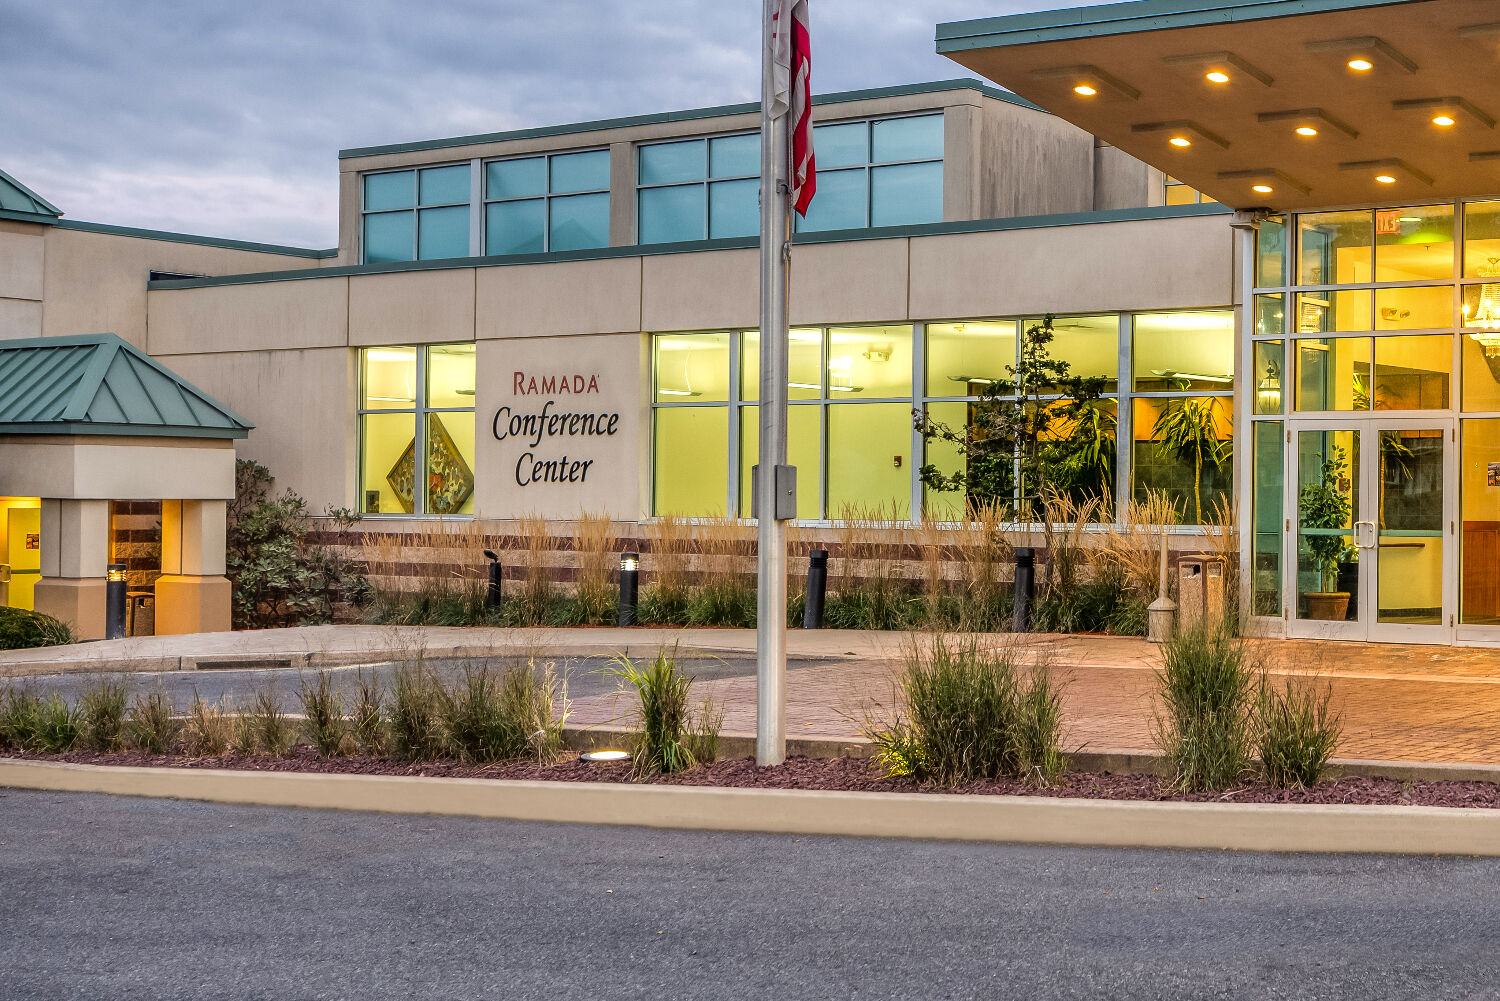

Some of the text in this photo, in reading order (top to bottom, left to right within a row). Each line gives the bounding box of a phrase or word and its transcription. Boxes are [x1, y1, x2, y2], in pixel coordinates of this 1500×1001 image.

[513, 371, 599, 396] RAMADA
[492, 400, 619, 448] Conference
[515, 452, 594, 487] Center
